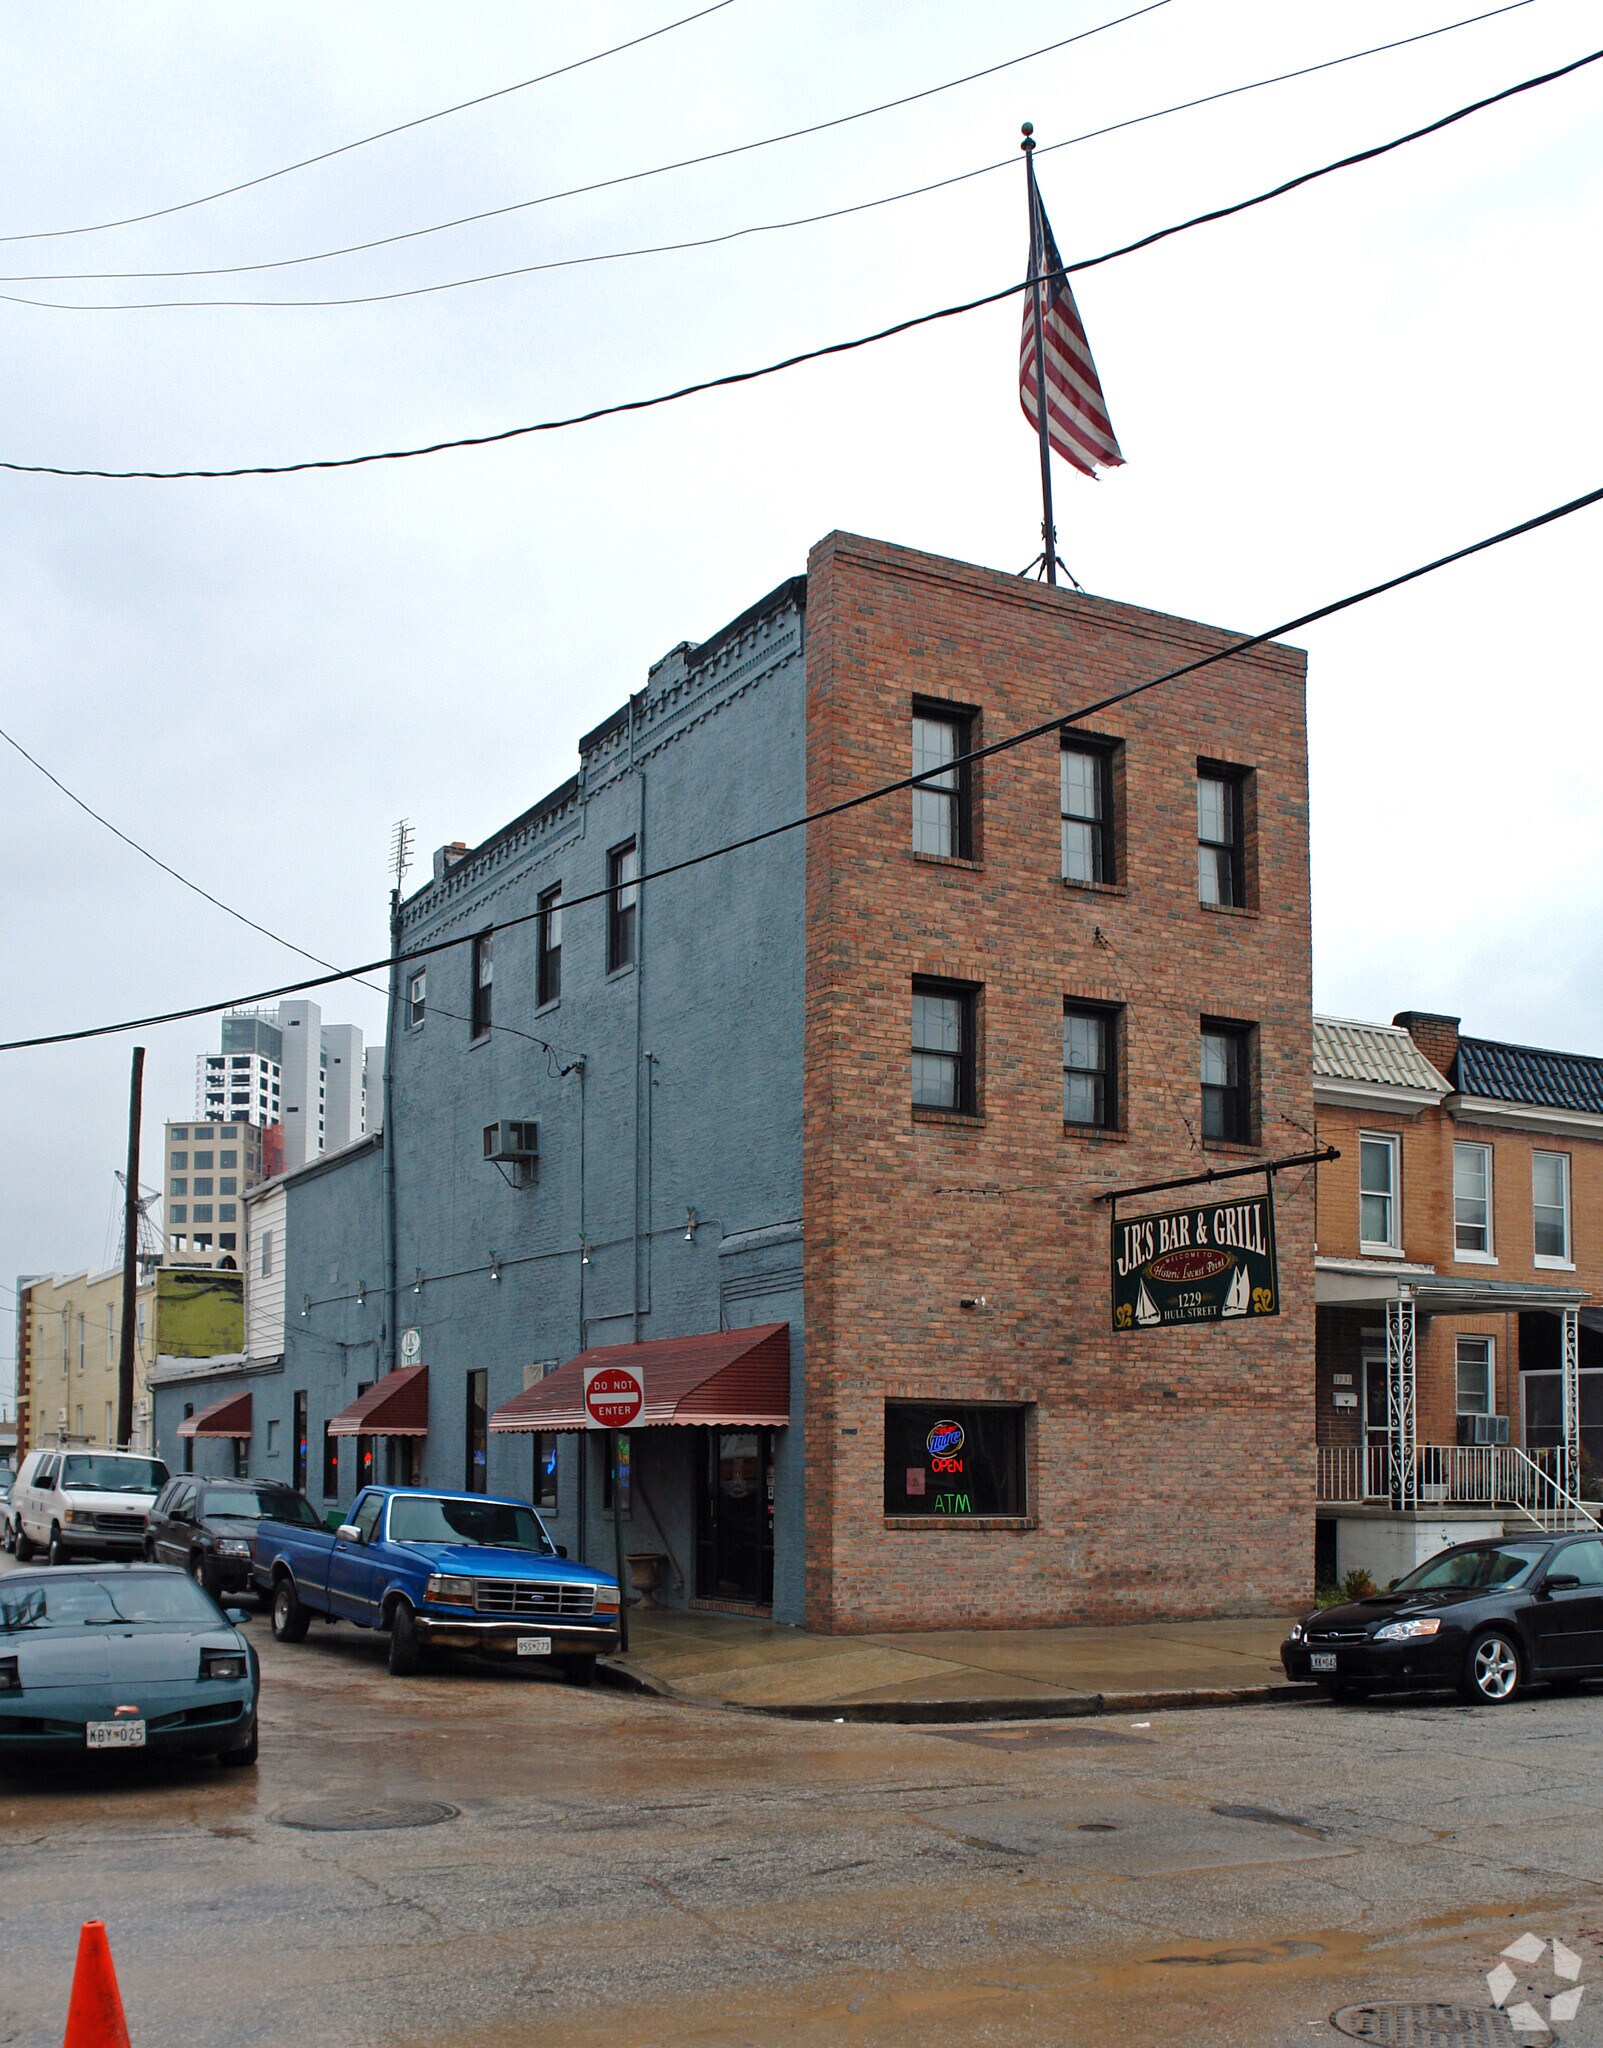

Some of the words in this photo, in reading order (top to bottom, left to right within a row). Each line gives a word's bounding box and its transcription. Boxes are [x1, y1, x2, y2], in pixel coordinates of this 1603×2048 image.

[1159, 1215, 1190, 1254] BAR
[1196, 1212, 1208, 1245] &
[1213, 1204, 1266, 1256] GRILL
[1165, 1251, 1200, 1264] WELCOME
[1153, 1262, 1181, 1279] Historic
[1182, 1262, 1204, 1279] Locust
[1206, 1257, 1225, 1274] Point
[1178, 1291, 1202, 1308] 1229
[1164, 1310, 1186, 1320] HULL
[1187, 1306, 1218, 1318] STREET
[594, 1381, 608, 1391] DO
[613, 1380, 633, 1390] NOT
[598, 1406, 631, 1416] ENTER
[931, 1458, 963, 1473] OPEN
[933, 1493, 971, 1513] ATM
[89, 1728, 112, 1743] KBY
